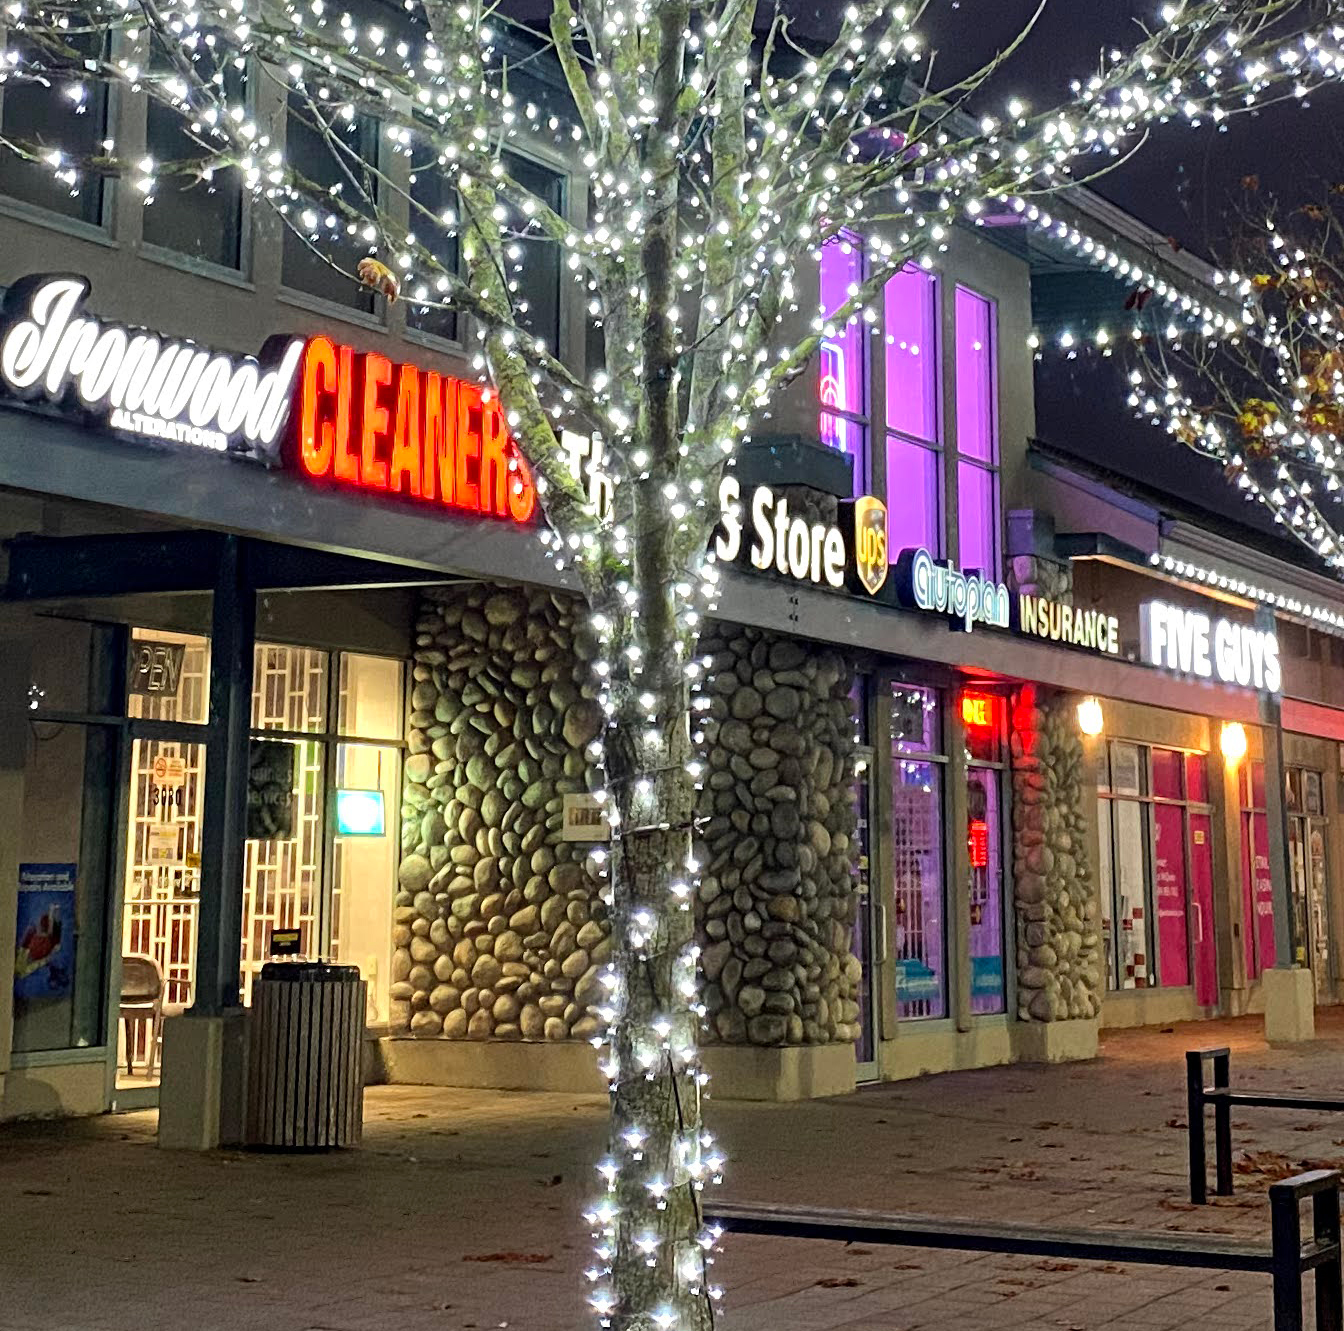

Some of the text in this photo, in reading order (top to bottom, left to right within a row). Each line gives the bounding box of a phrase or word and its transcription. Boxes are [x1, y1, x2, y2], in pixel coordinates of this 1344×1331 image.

[3, 279, 305, 444] Ironwood
[110, 408, 228, 452] ALTERATIONS
[750, 485, 846, 588] Store
[1019, 593, 1119, 654] INSURANCE
[1150, 599, 1281, 694] FIVE GUYS
